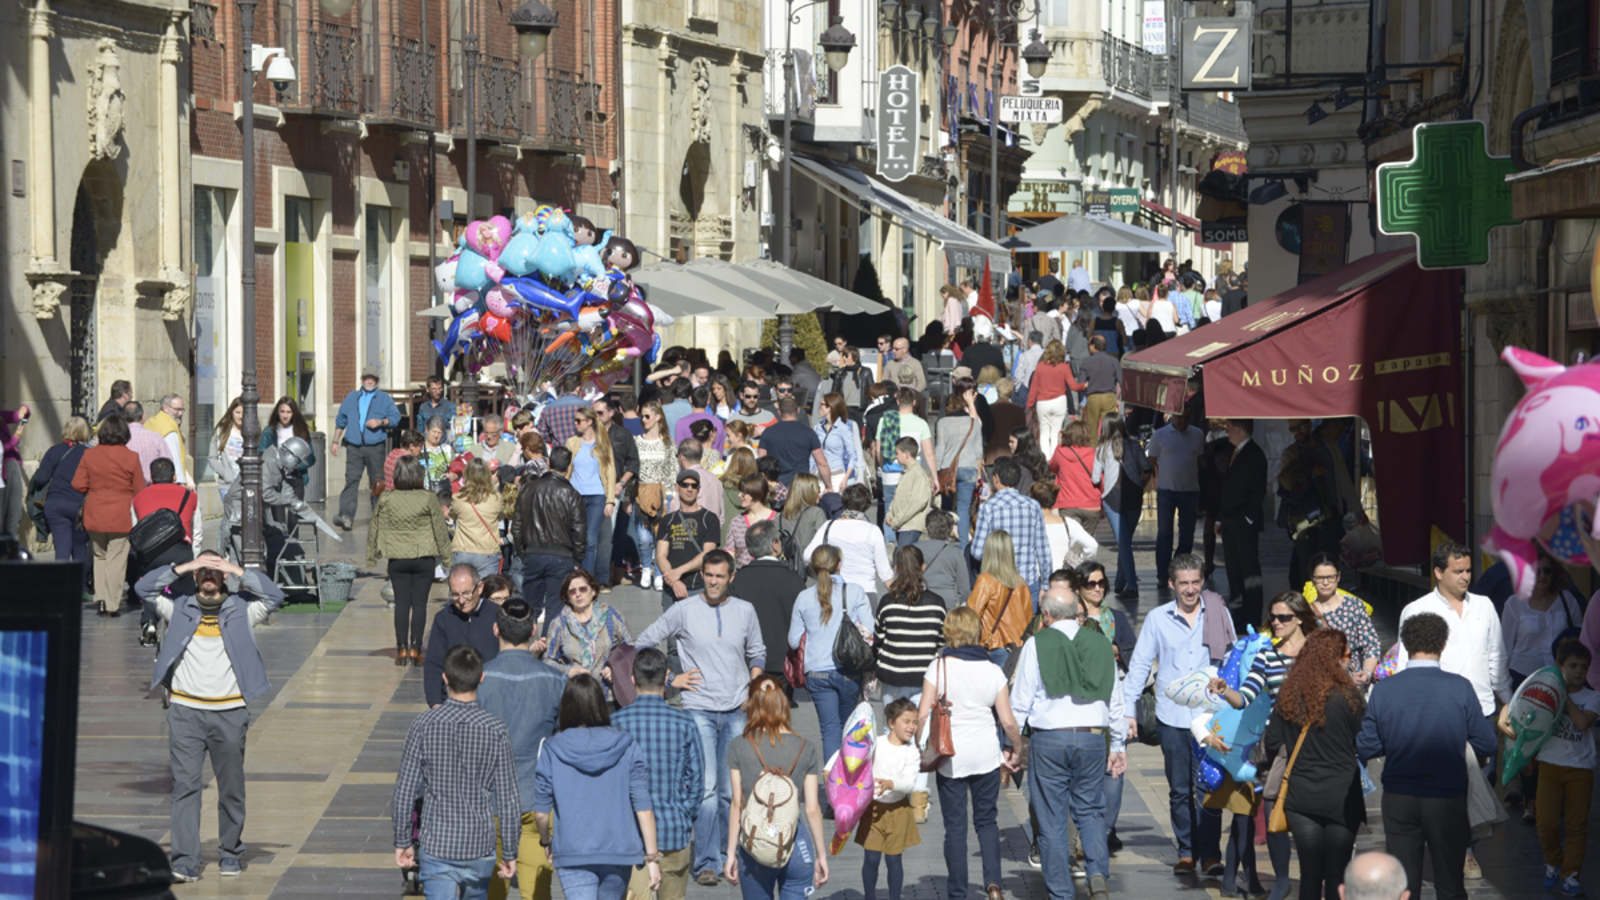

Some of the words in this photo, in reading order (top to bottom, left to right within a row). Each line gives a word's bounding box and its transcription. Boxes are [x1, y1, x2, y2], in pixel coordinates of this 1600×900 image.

[1144, 32, 1164, 42] VENDE
[1191, 24, 1240, 85] Z
[1002, 98, 1060, 111] PELUQUERIA
[886, 74, 910, 160] HOTEL
[1012, 110, 1048, 122] MIXTA
[1241, 363, 1364, 387] MUÑOZ
